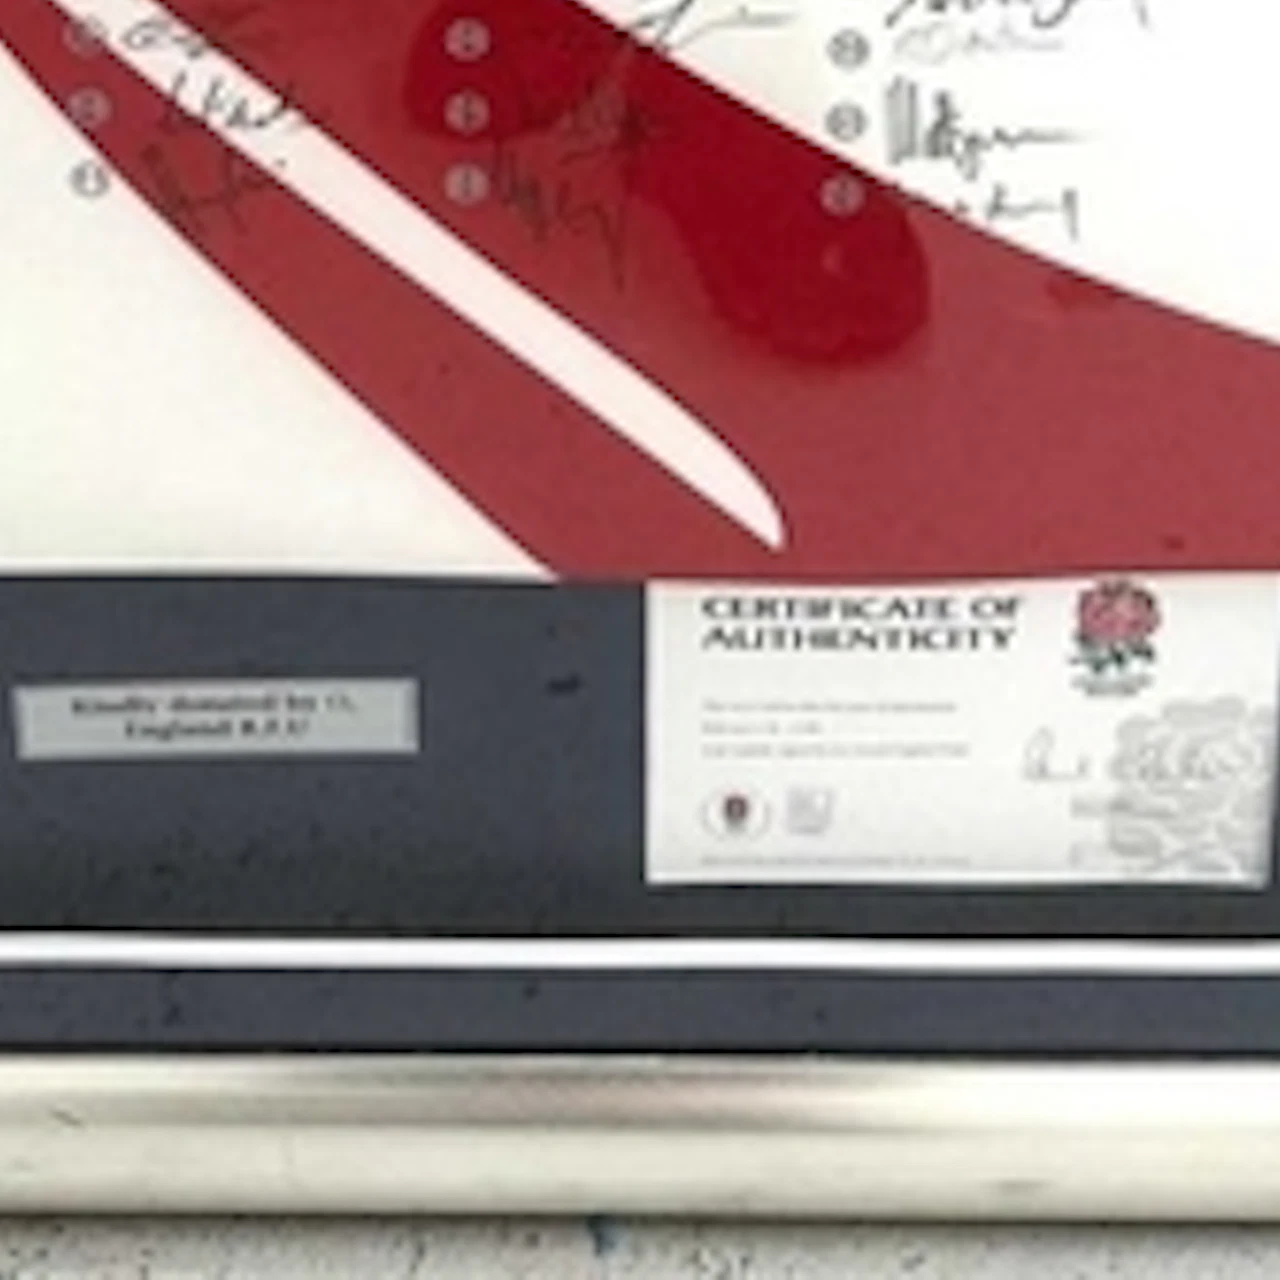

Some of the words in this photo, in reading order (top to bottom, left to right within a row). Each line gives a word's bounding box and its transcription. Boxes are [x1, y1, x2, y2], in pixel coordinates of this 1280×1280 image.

[701, 597, 954, 620] CERTIFICATE
[969, 597, 1020, 620] OF
[701, 627, 1018, 651] AUTHENTICITY
